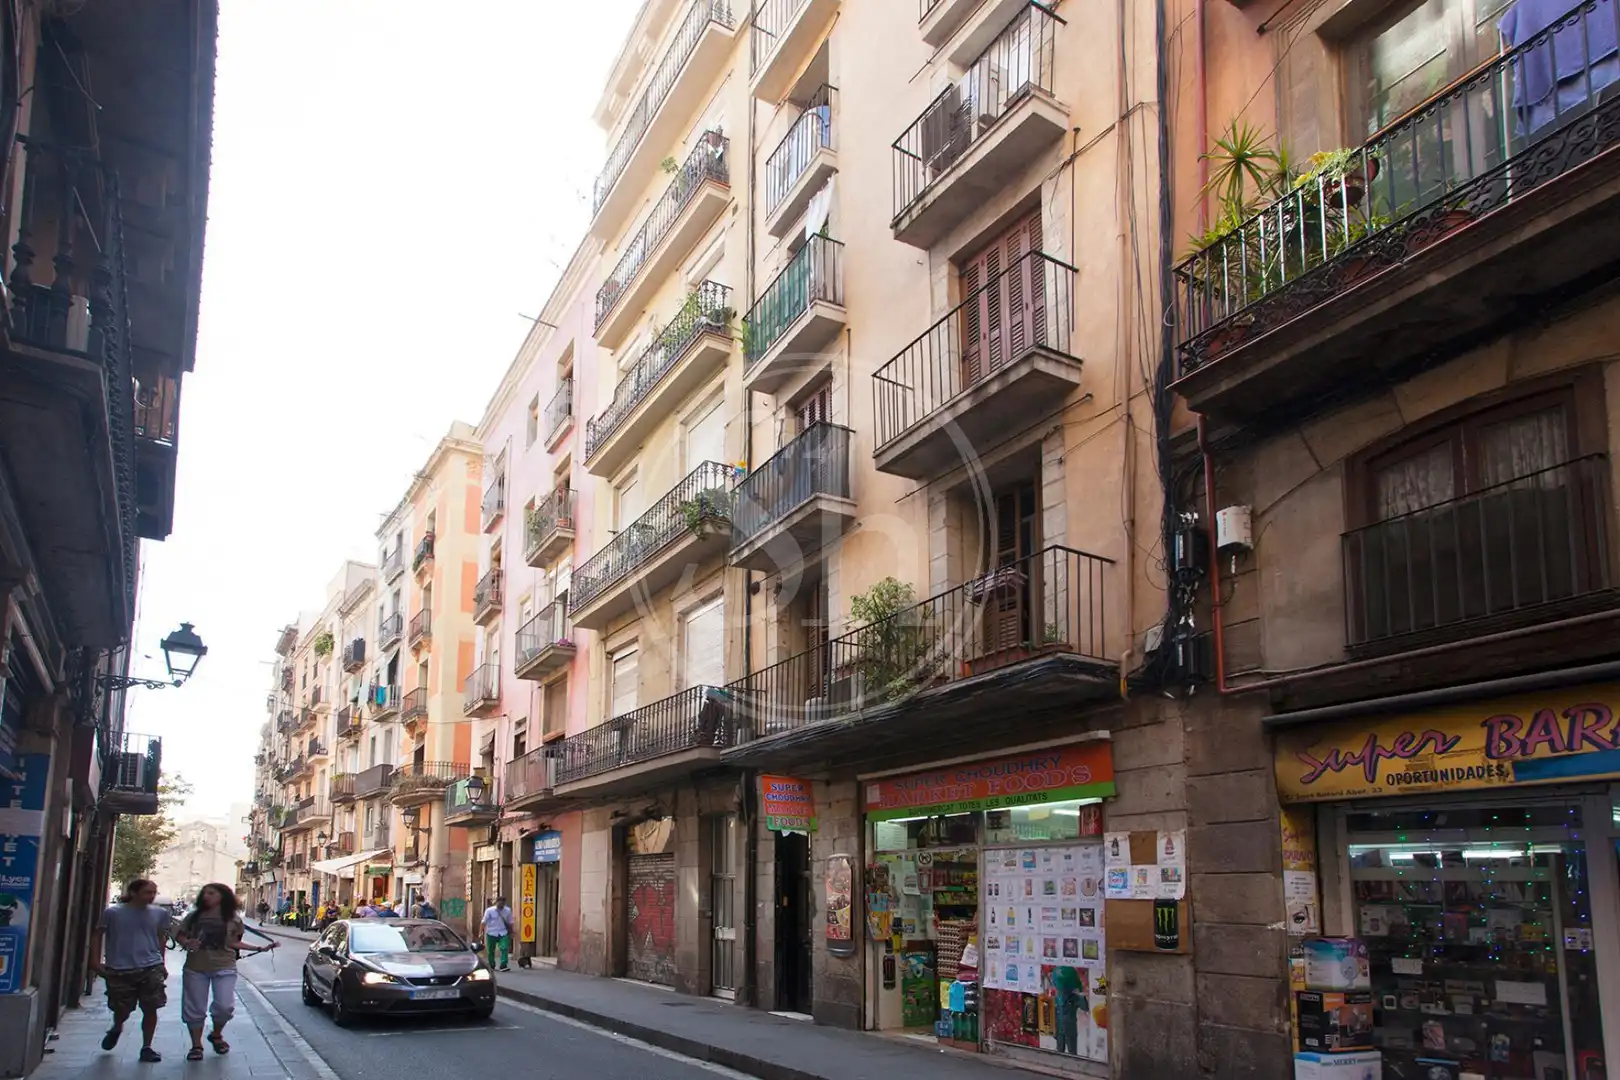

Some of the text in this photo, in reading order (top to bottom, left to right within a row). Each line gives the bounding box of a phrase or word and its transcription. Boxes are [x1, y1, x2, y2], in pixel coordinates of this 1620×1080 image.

[1296, 702, 1620, 784] Super BAR
[771, 783, 804, 792] SUPER
[878, 765, 1092, 809] MARKET FOOD'S
[894, 754, 1062, 791] SUPER CHOUDHRY
[958, 800, 981, 811] TOTES
[985, 797, 1000, 808] LES
[1004, 791, 1048, 806] QUALITATS
